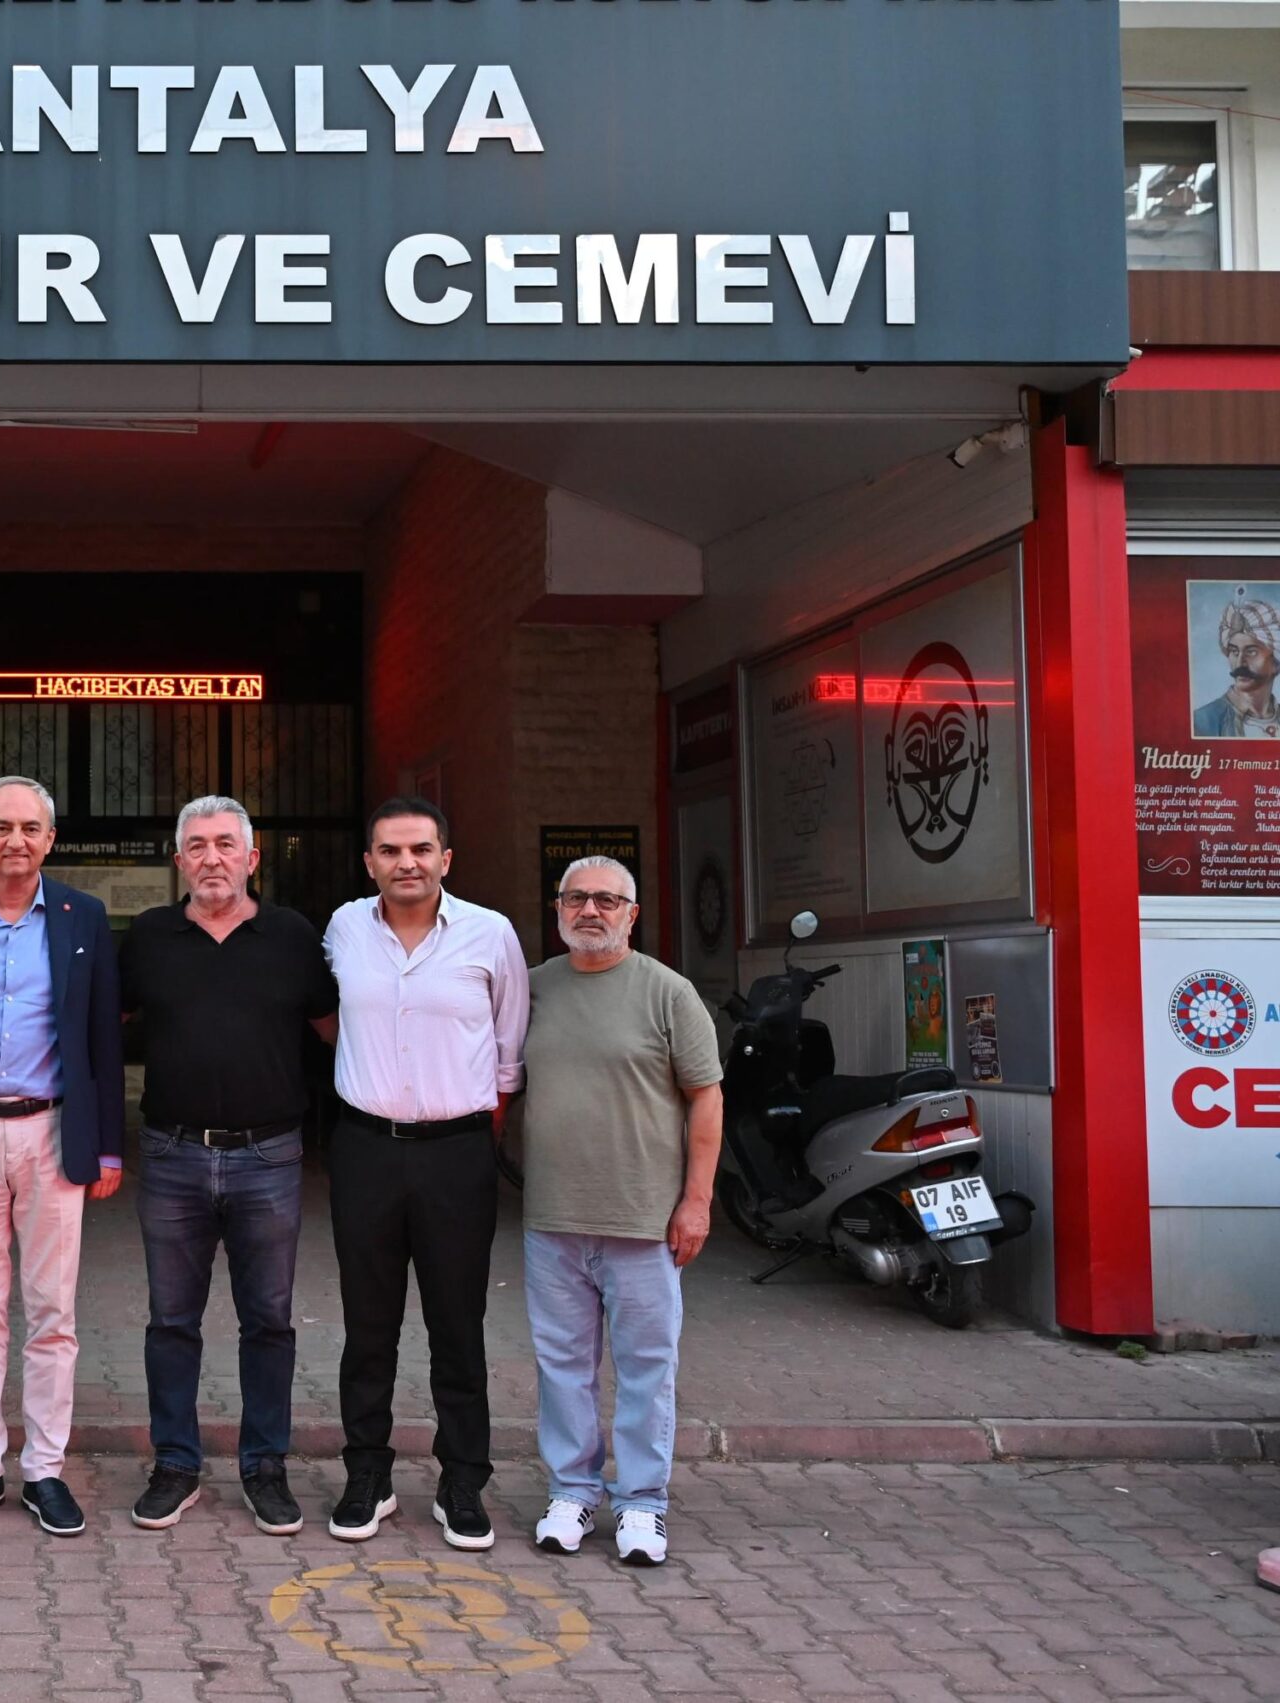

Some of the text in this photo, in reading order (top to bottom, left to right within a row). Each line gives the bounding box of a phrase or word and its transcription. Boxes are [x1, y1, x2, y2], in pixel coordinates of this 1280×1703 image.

[149, 233, 333, 325] VE
[383, 211, 917, 326] CEMEVİ
[1142, 746, 1211, 780] Hatayi
[1219, 759, 1230, 770] 17
[1232, 759, 1272, 770] Temmuz
[1149, 784, 1173, 798] gözlü
[1174, 784, 1197, 797] pirim
[1161, 798, 1187, 810] gelsin
[1203, 798, 1239, 810] meydan.
[1135, 809, 1154, 819] Dört
[1182, 809, 1199, 820] kırk
[1254, 810, 1267, 821] On
[1157, 822, 1182, 835] gelsin
[1199, 822, 1235, 835] meydan.
[1212, 841, 1229, 854] gün
[1230, 841, 1248, 851] olur
[1200, 853, 1247, 868] Safasından
[1248, 854, 1269, 864] artık
[1200, 866, 1228, 877] Gerçek
[1229, 866, 1267, 877] erenlerin
[1201, 878, 1218, 889] Biri
[1200, 972, 1235, 984] ANADOLU
[929, 1094, 959, 1106] HONDA
[916, 1179, 982, 1208] 07 AIF
[946, 1204, 968, 1223] 19
